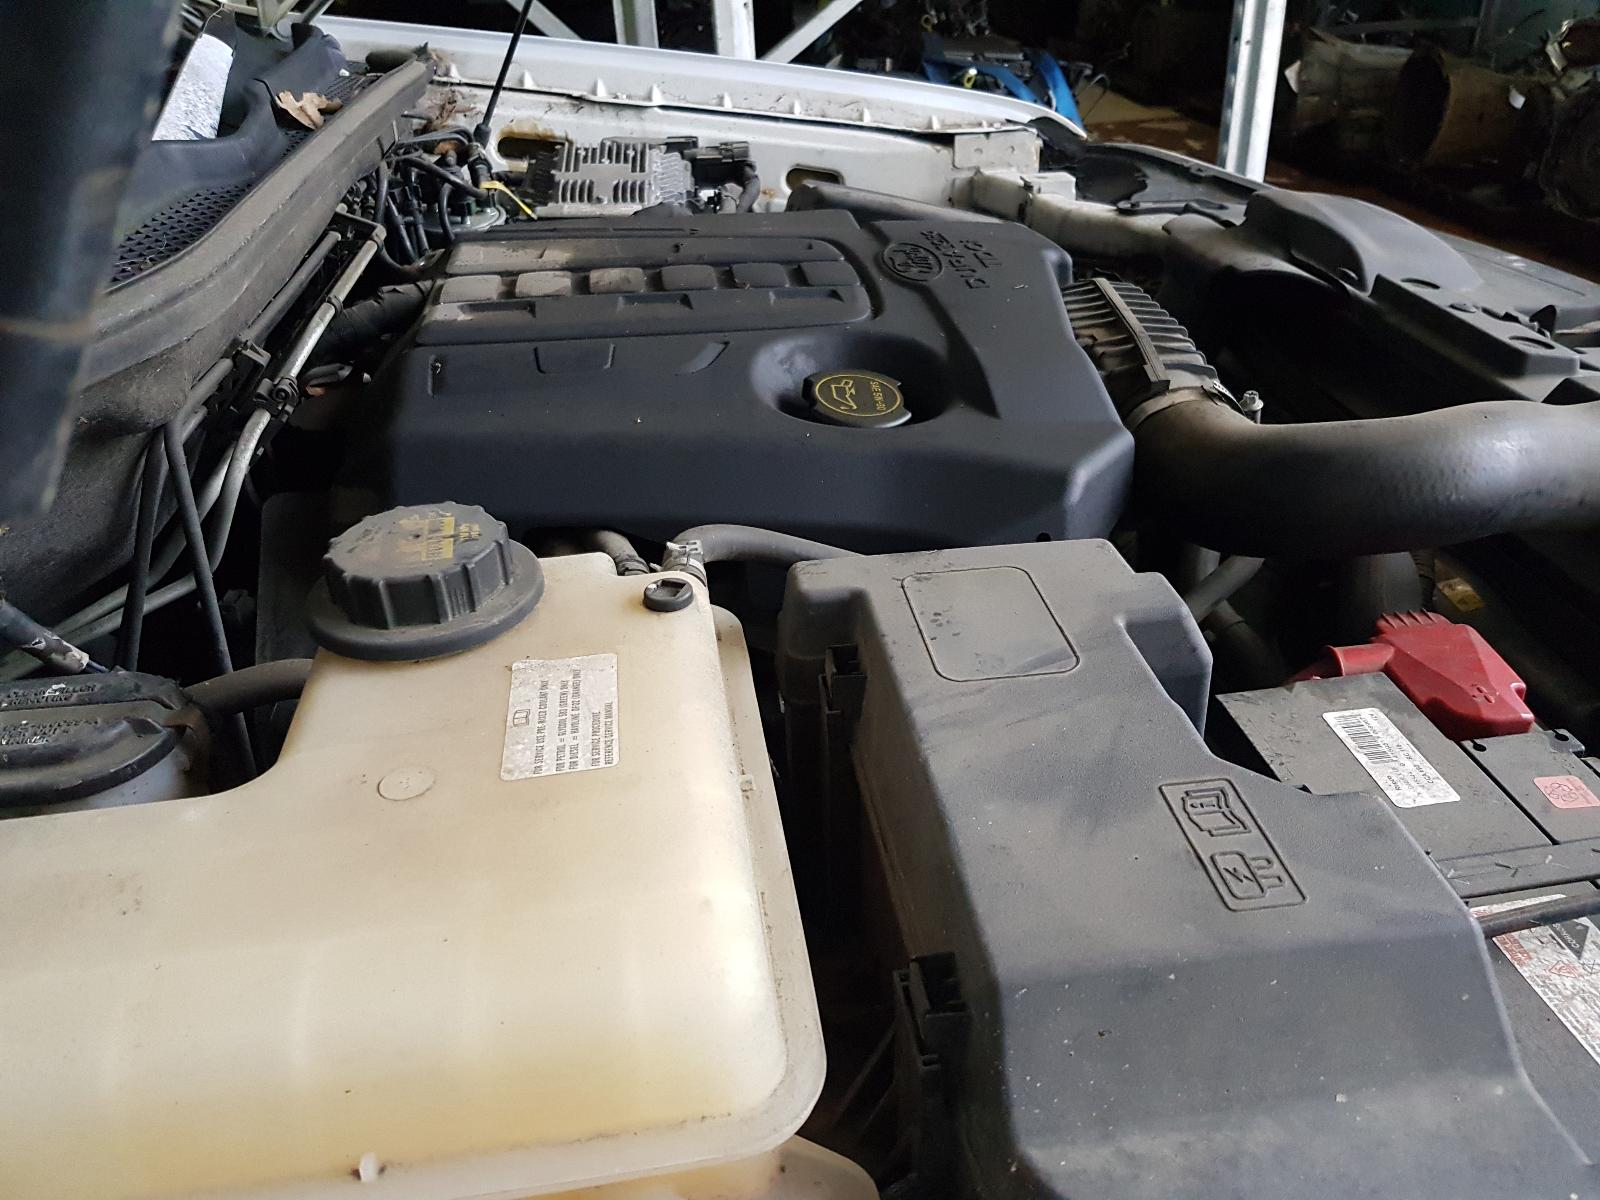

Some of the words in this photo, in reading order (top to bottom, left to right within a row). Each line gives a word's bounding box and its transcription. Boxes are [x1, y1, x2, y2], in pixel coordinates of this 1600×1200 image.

[539, 691, 548, 709] COOLANT
[537, 735, 545, 743] USE
[535, 745, 543, 764] SERVICE
[557, 745, 565, 761] PETROL
[570, 744, 578, 759] DIESEL
[592, 738, 600, 756] SERVICE
[592, 758, 600, 766] FOR
[534, 766, 542, 774] FOR
